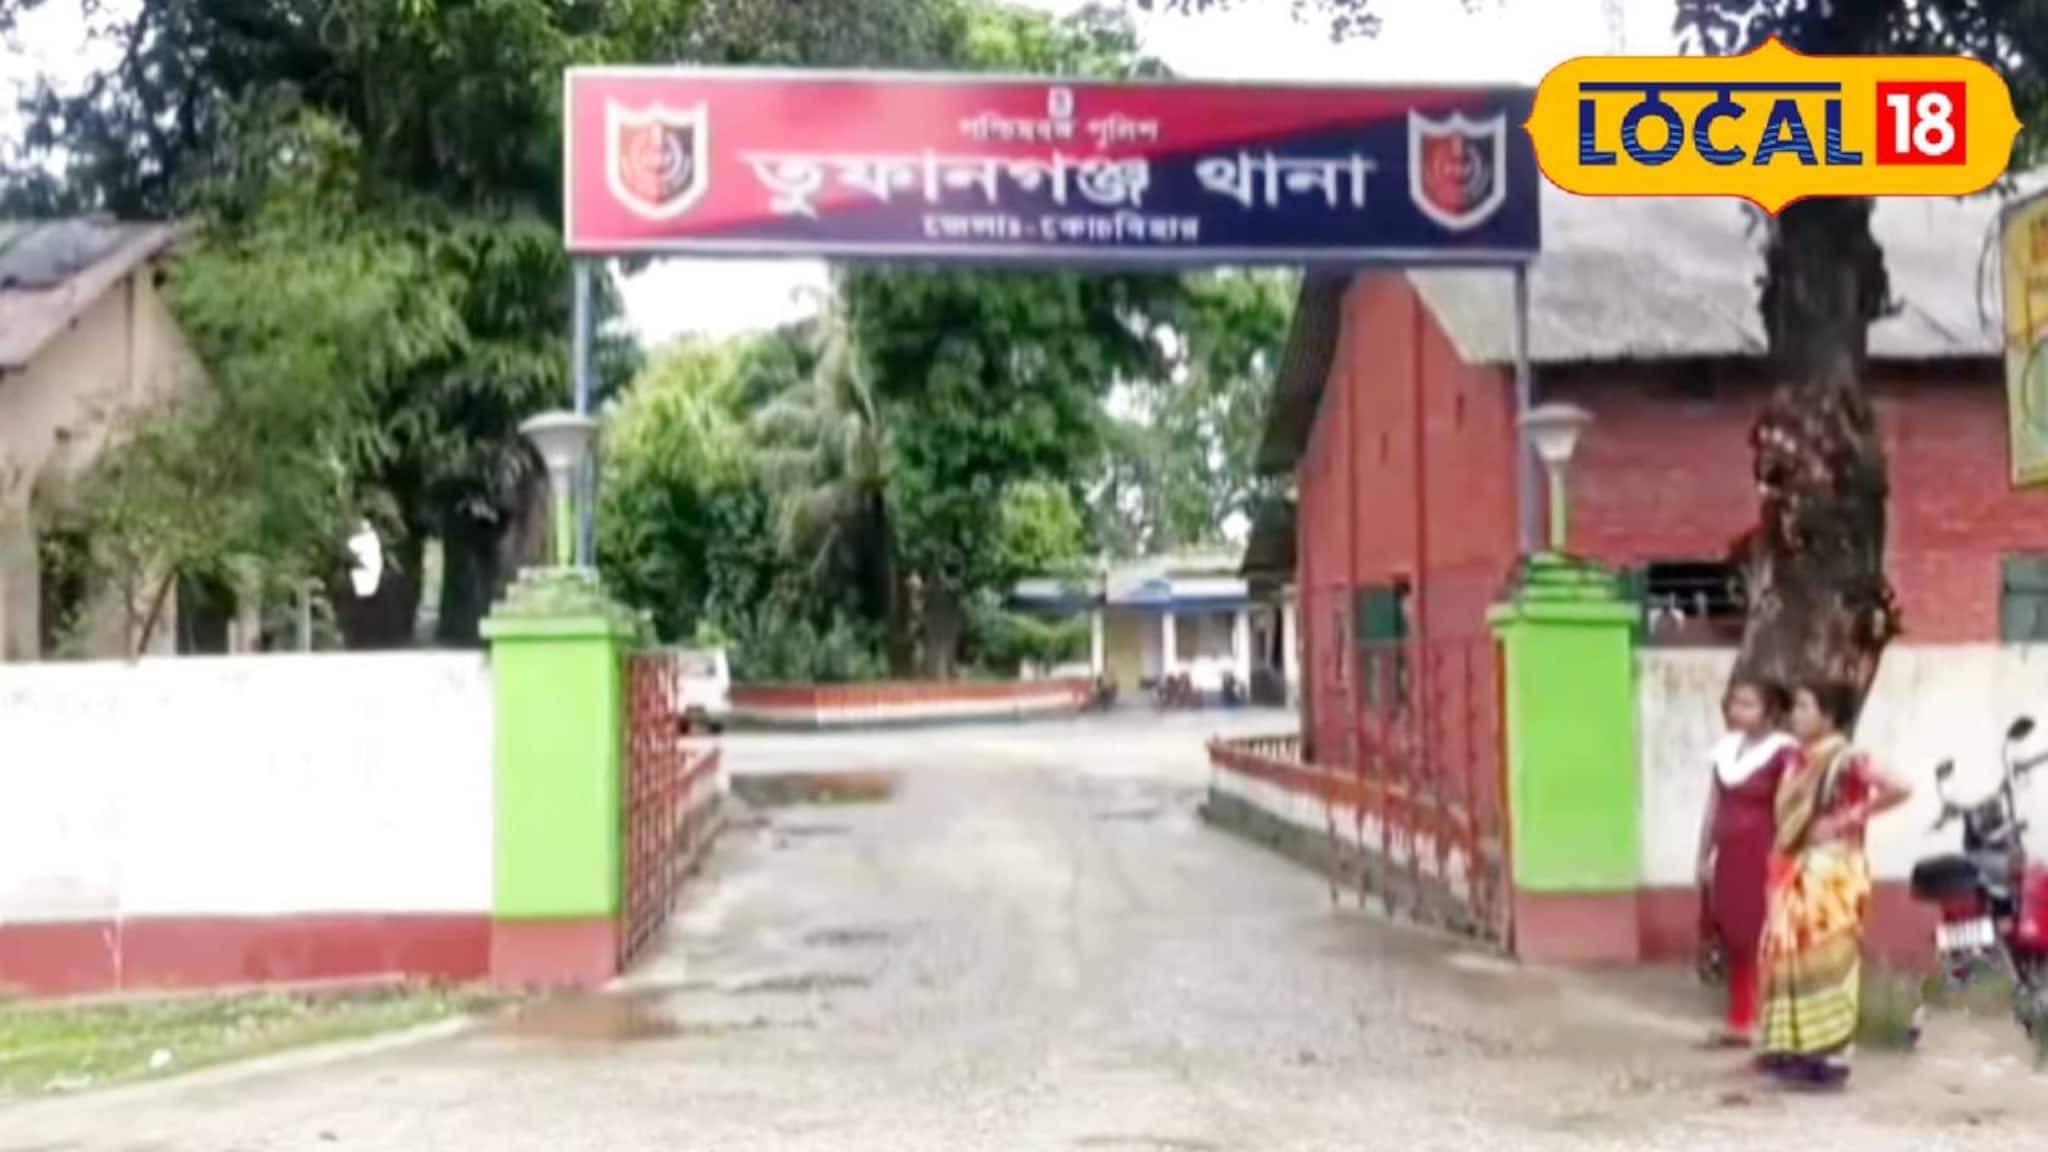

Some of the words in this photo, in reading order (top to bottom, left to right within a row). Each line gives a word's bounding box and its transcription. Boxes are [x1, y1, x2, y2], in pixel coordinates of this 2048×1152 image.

[1086, 113, 1159, 150] পুলিশ
[737, 149, 1150, 219] তুফানগঞ্জ
[1195, 150, 1376, 209] থানা
